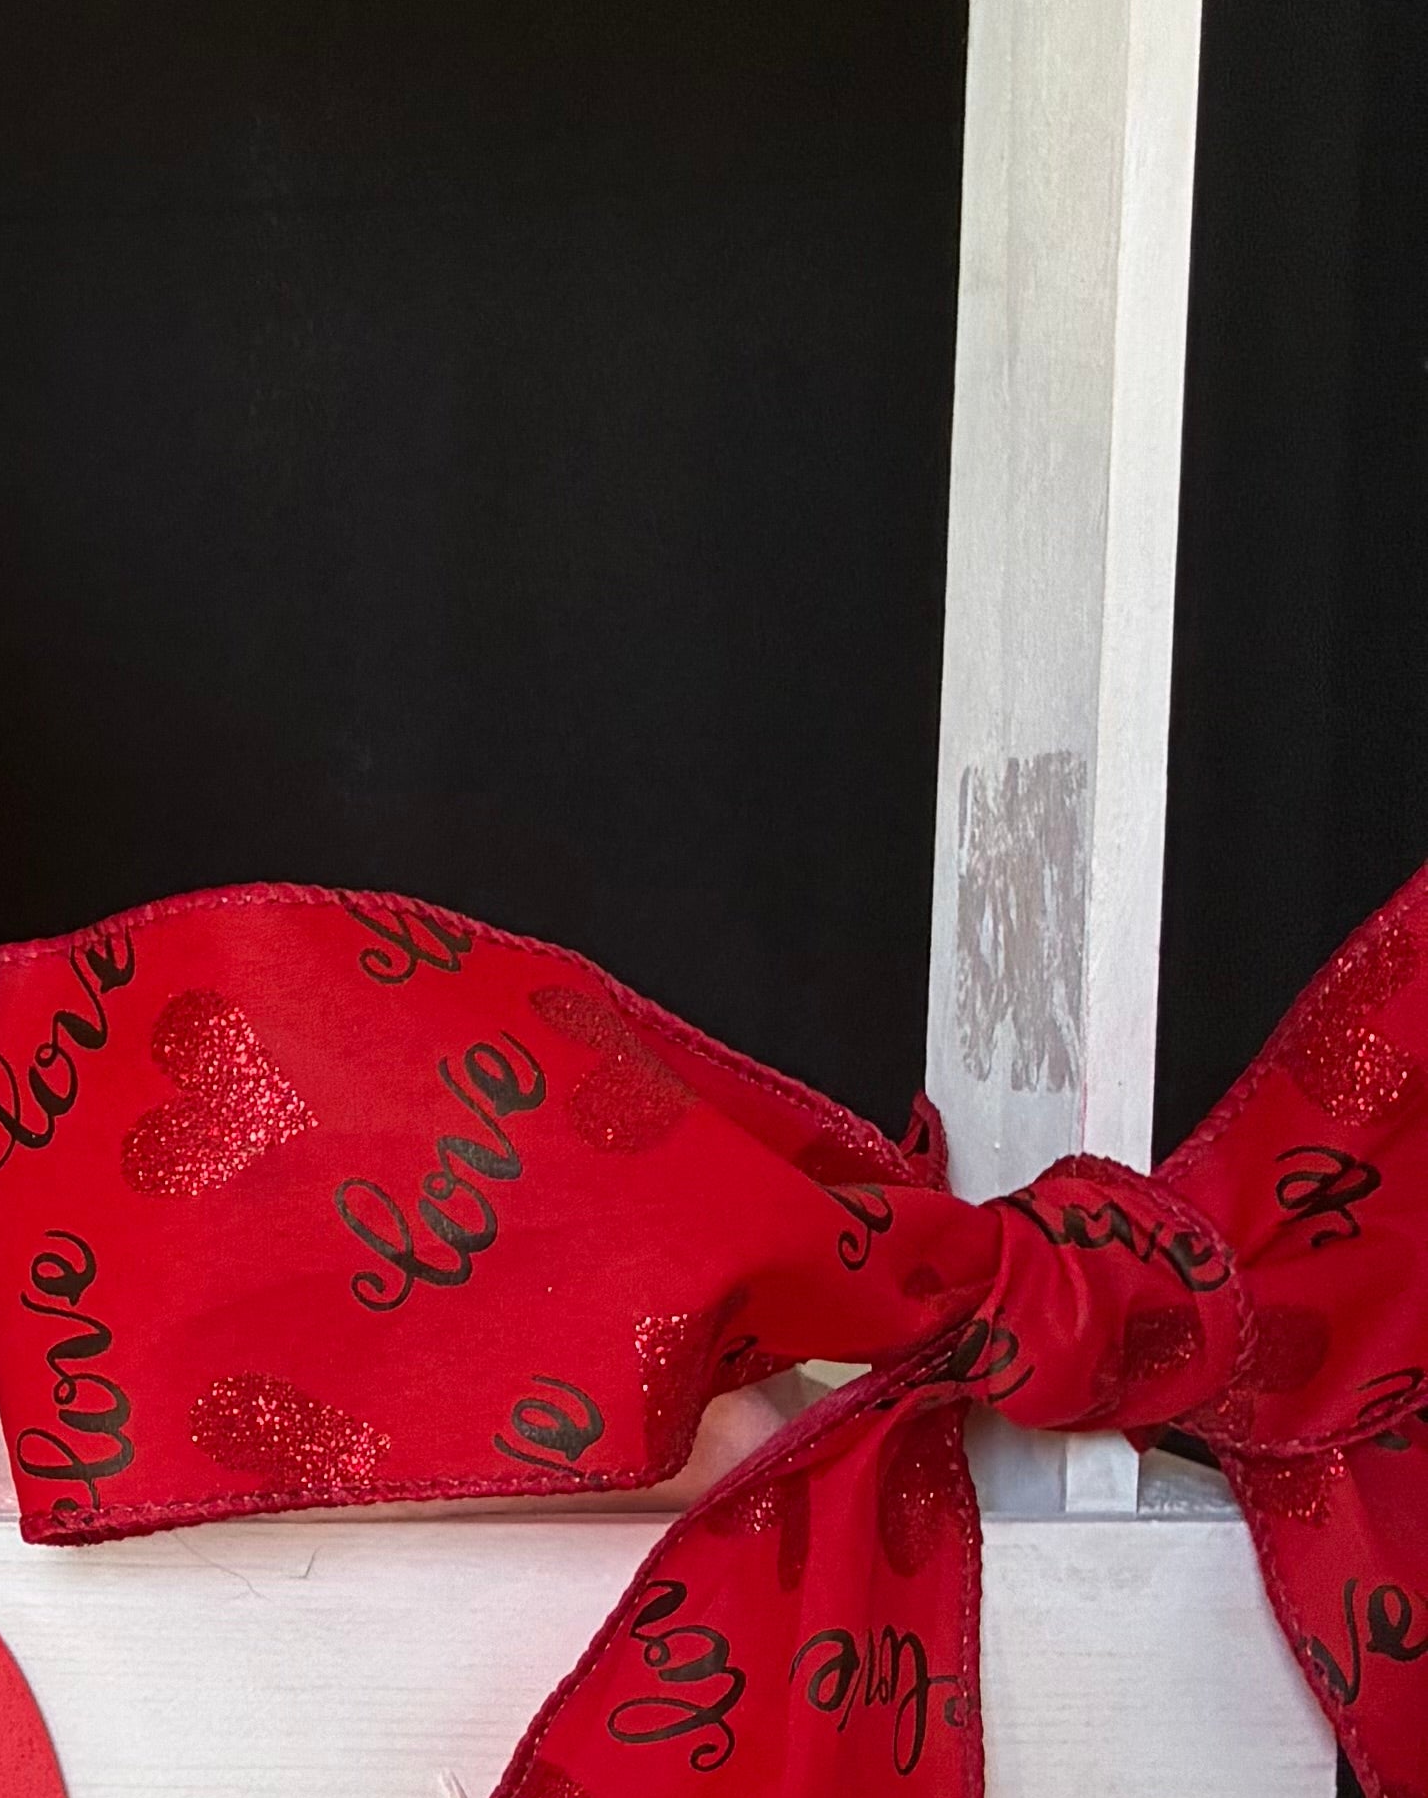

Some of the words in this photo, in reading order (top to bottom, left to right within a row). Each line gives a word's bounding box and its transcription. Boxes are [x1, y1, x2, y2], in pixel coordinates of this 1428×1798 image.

[334, 1031, 546, 1313] love
[17, 1229, 136, 1481] love
[1302, 1576, 1428, 1706] ve
